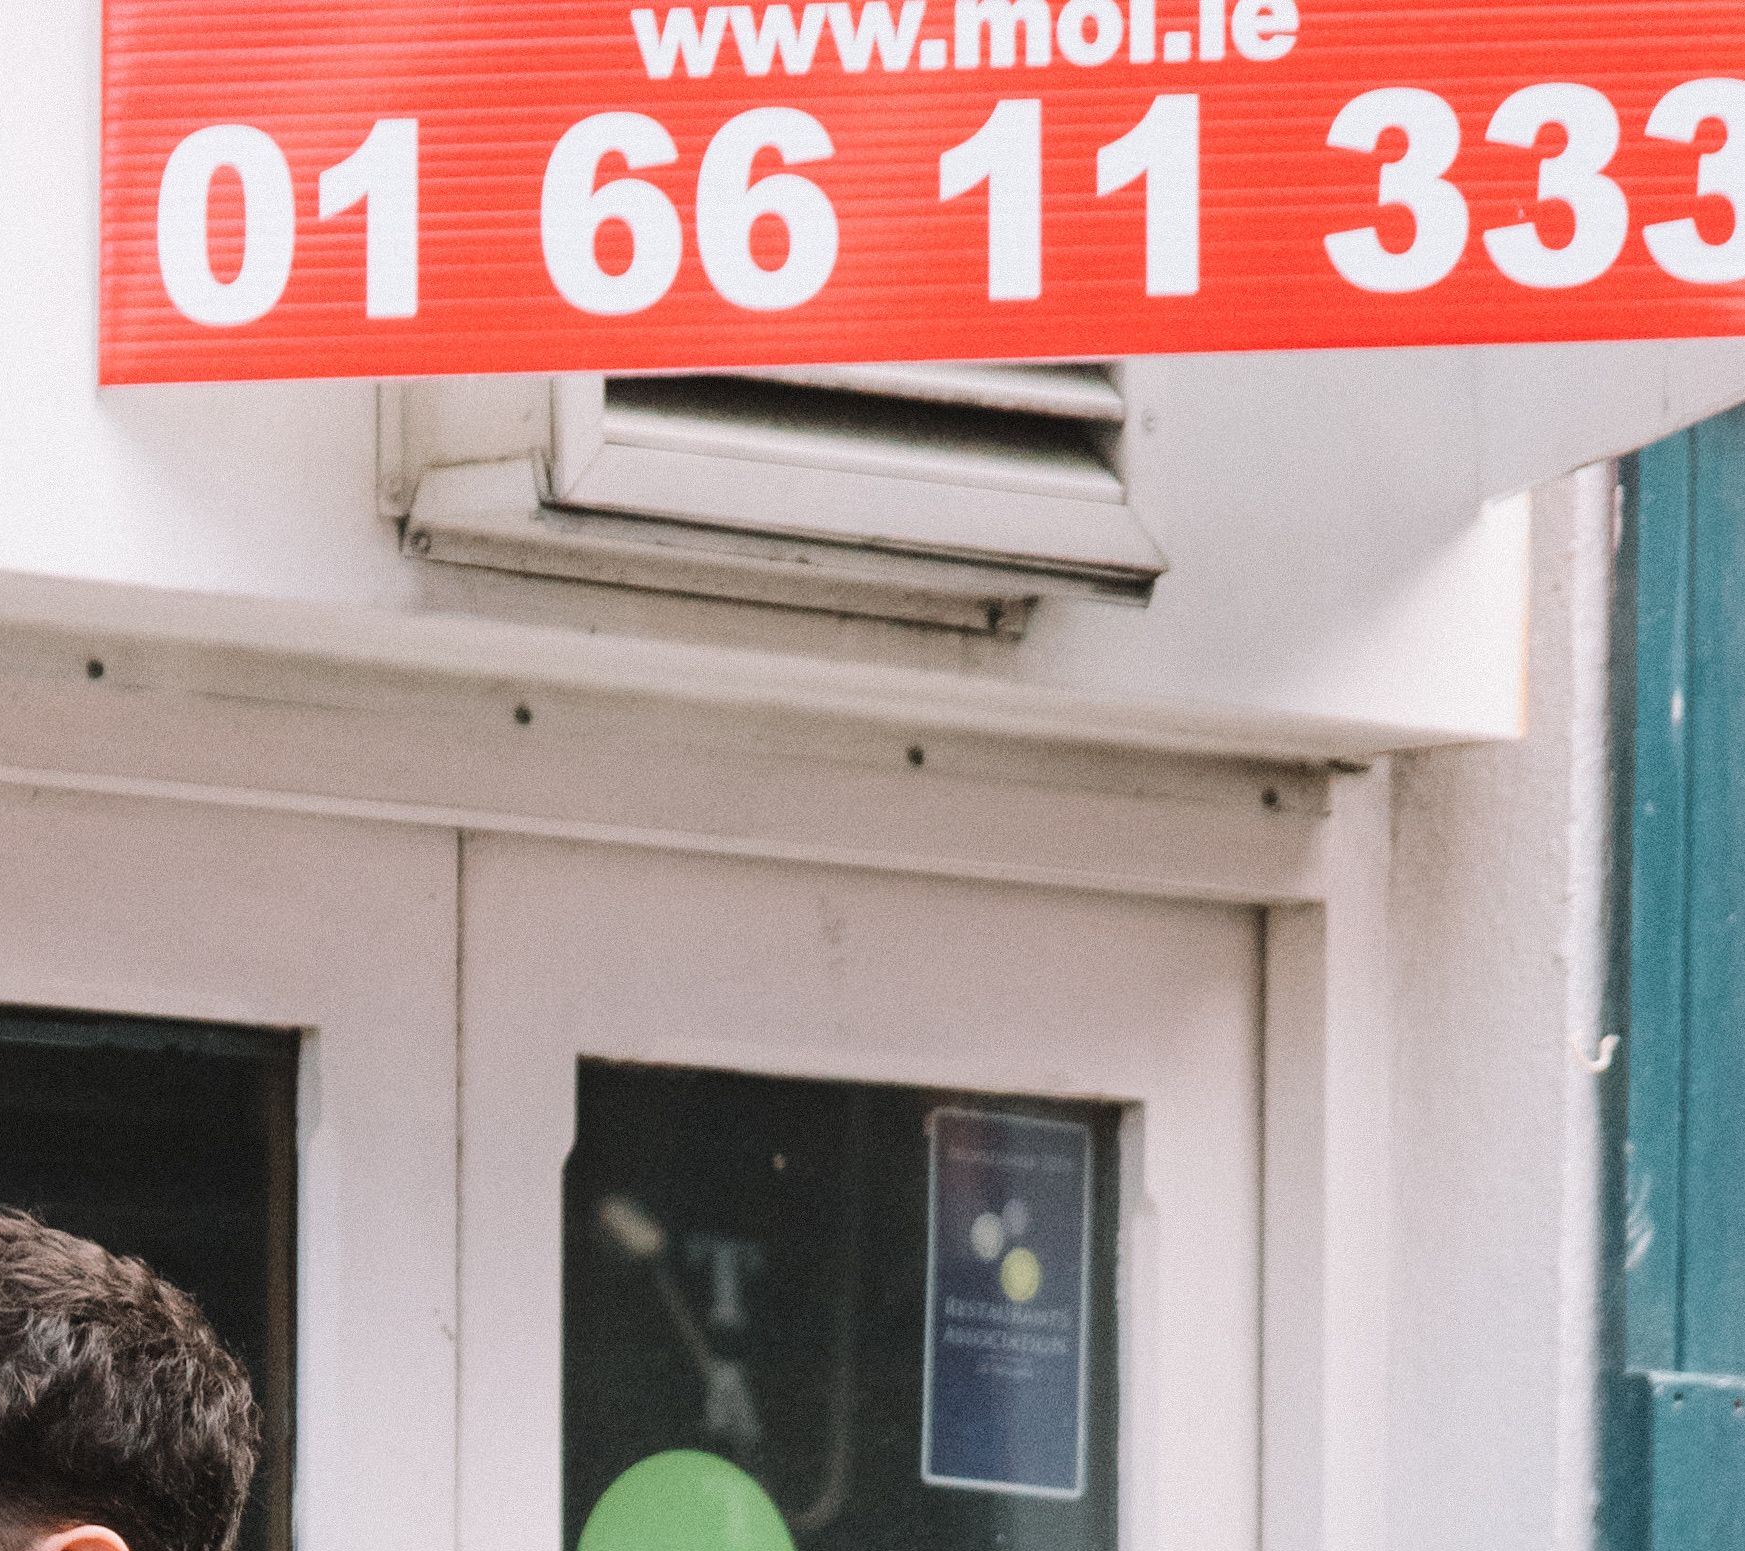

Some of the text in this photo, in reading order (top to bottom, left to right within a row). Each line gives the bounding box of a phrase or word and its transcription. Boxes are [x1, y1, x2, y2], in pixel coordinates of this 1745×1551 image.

[154, 76, 1745, 327] 01 66 11 333
